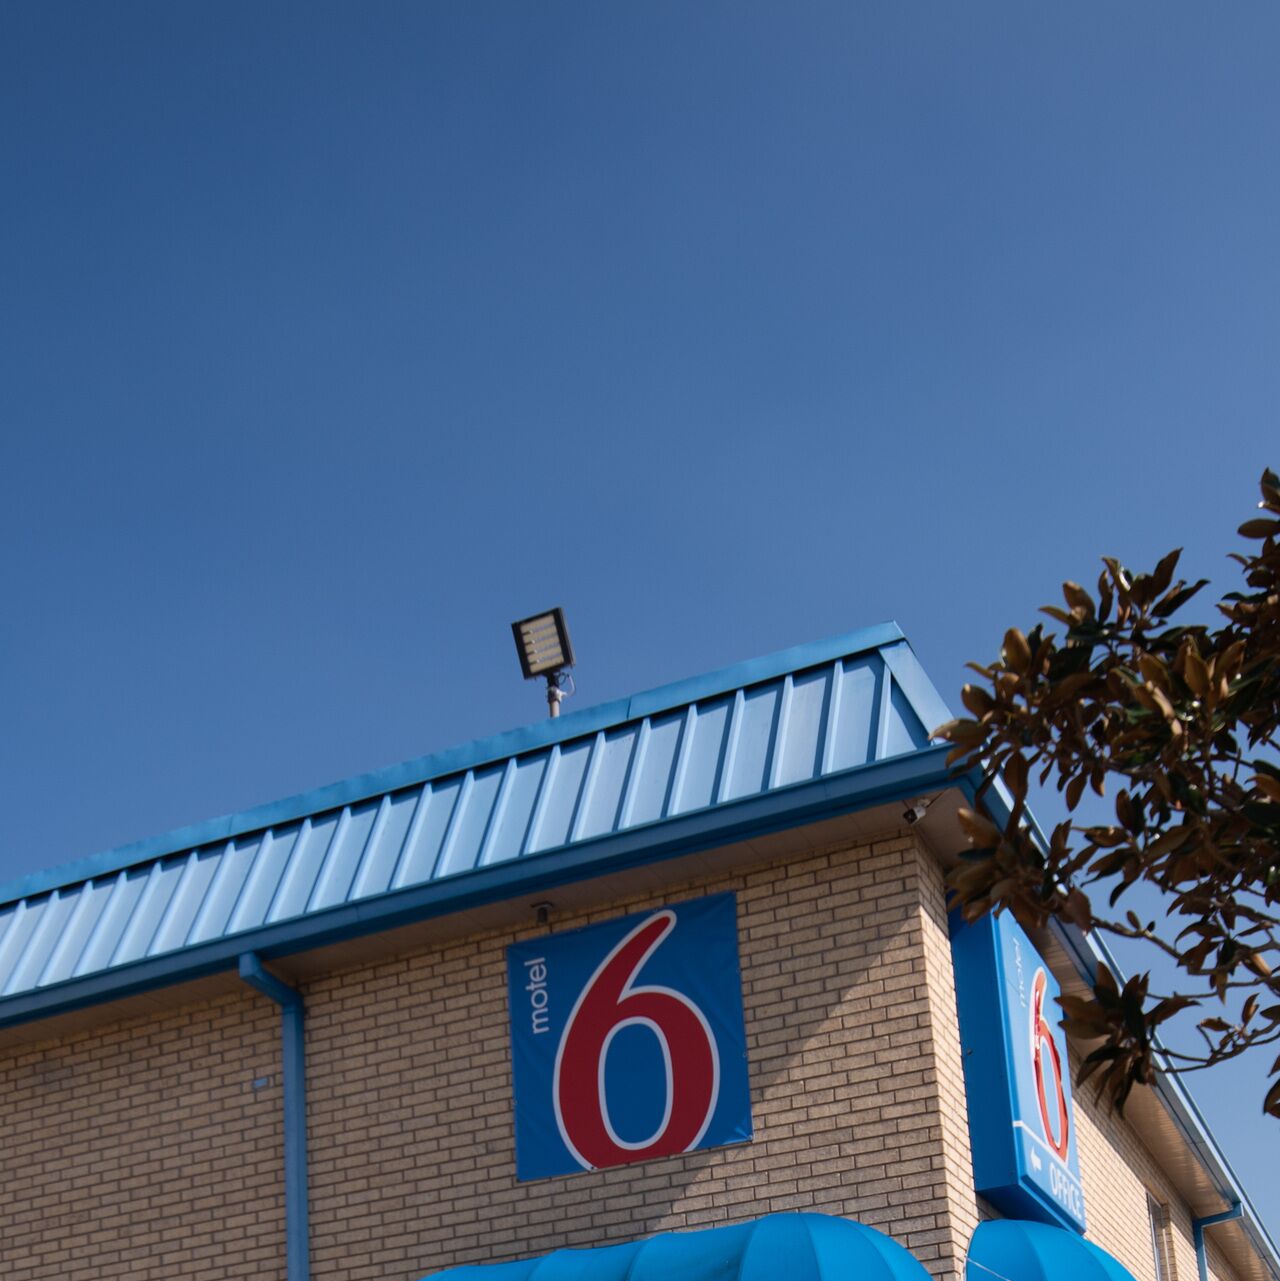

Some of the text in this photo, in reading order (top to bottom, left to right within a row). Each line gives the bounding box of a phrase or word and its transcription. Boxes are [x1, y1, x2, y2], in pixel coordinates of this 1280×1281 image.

[524, 909, 721, 1171] motel 6
[1029, 966, 1070, 1165] 6
[1049, 1162, 1083, 1220] OFFICE
